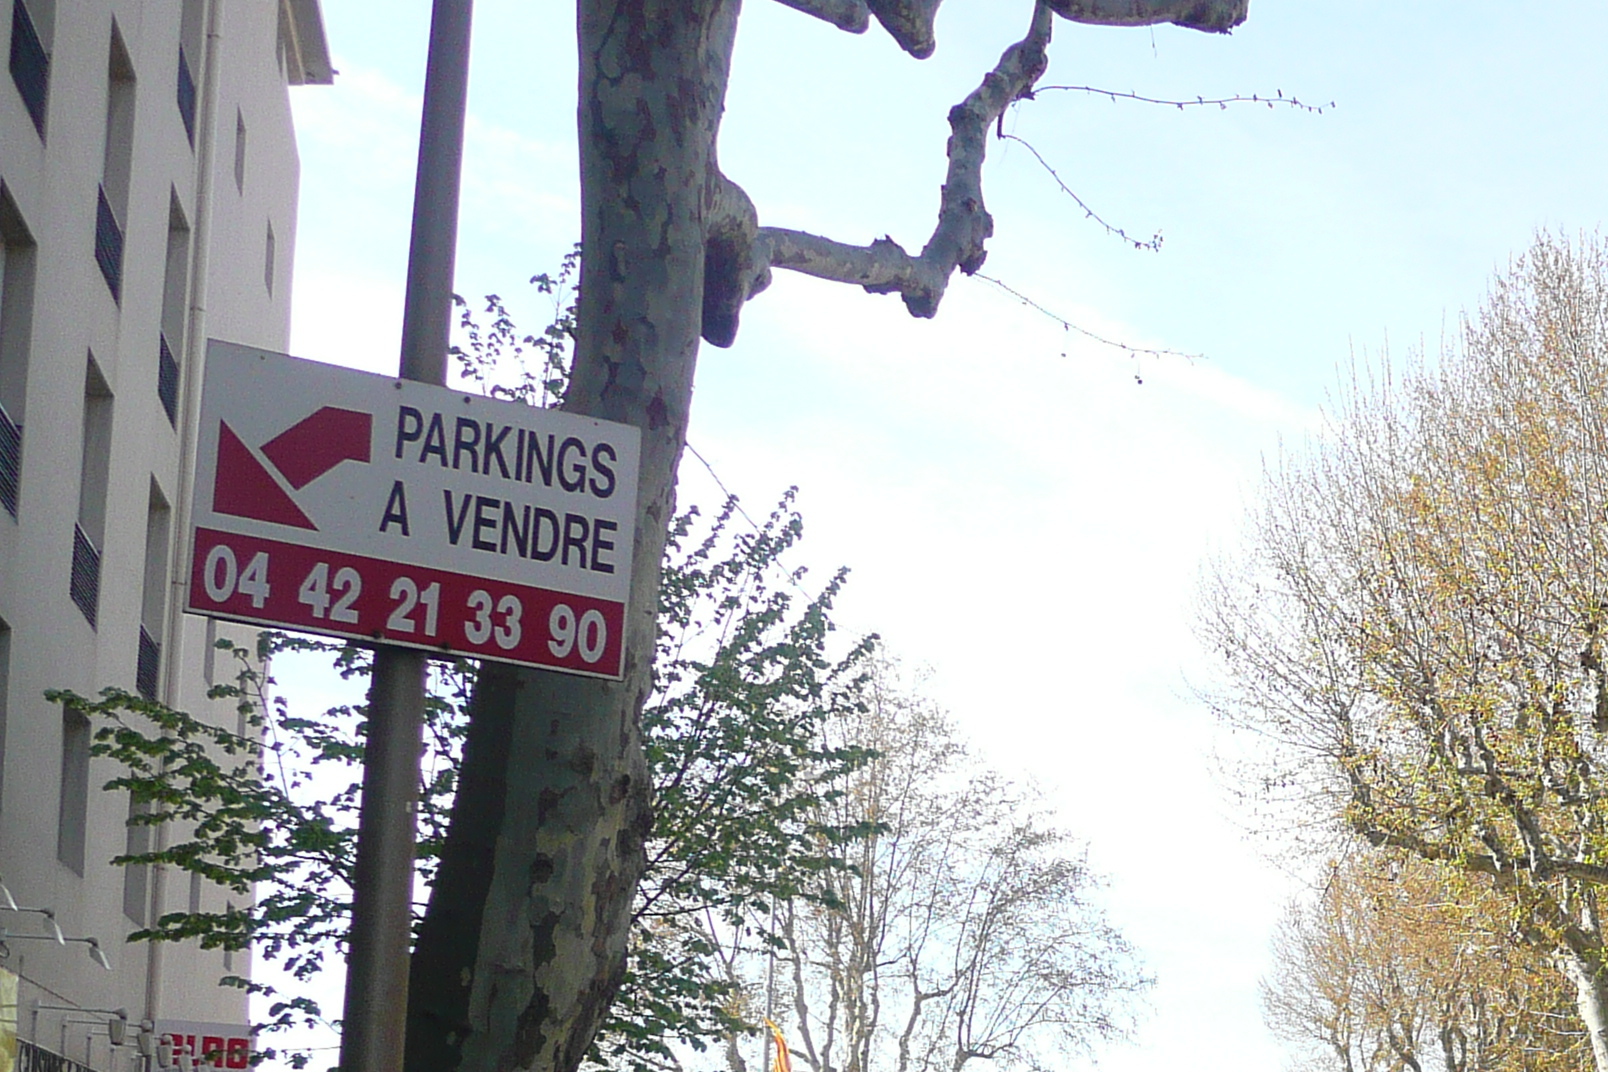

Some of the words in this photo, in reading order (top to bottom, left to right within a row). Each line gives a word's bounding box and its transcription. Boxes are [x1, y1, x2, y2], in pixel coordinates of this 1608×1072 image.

[395, 406, 617, 499] PARKINGS
[379, 480, 410, 537] A
[443, 490, 618, 575] VENDRE
[204, 545, 270, 609] 04
[299, 562, 361, 624] 42
[387, 577, 441, 637] 21
[464, 590, 521, 650] 33
[548, 604, 607, 664] 90
